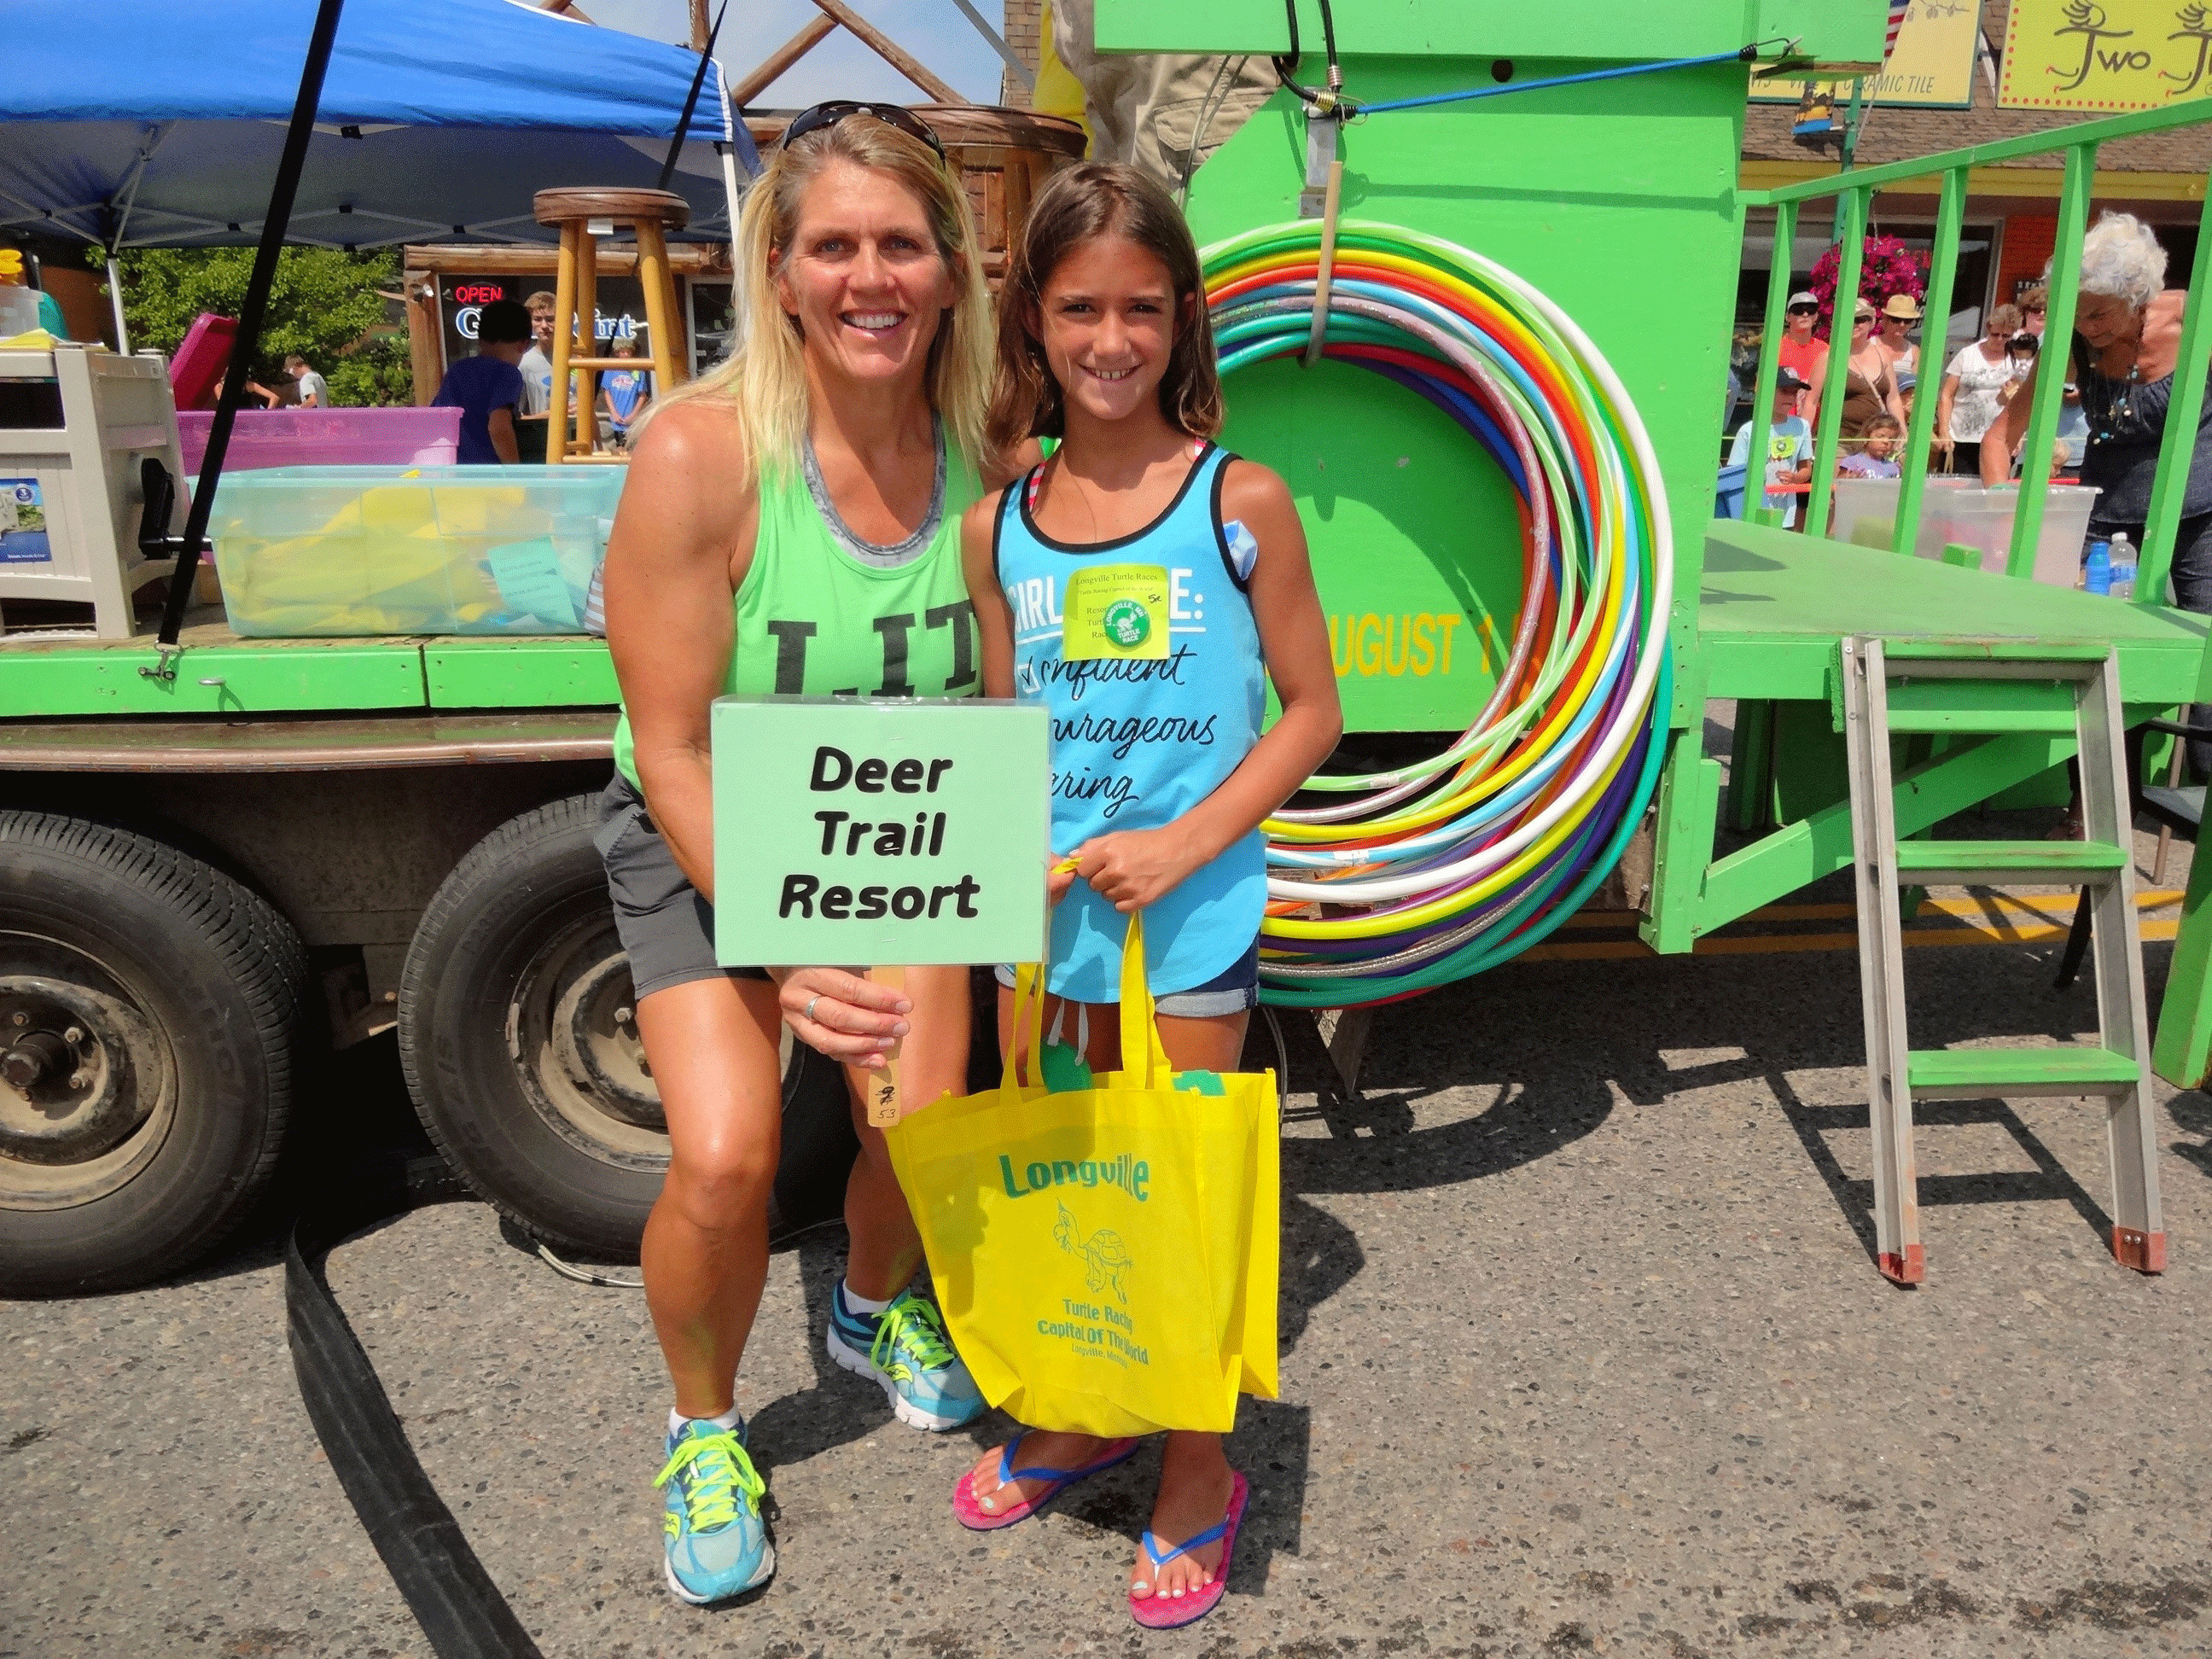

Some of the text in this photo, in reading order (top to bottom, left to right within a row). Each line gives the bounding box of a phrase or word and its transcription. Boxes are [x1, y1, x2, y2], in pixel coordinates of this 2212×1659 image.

[1907, 75, 1936, 94] TILE
[455, 286, 503, 303] OPEN
[1075, 574, 1110, 585] Longville
[1112, 573, 1134, 581] Turtle
[1086, 607, 1108, 615] Resor
[1087, 619, 1103, 627] Turt
[1117, 628, 1141, 638] TURTLE
[1122, 634, 1139, 643] RACE
[1329, 611, 1462, 678] UGUST
[1022, 643, 1198, 701] nfident
[1053, 713, 1218, 760] urageous
[810, 745, 954, 794] Deer
[1051, 766, 1139, 818] ring
[814, 810, 947, 857] Trail
[778, 874, 981, 920] Resort
[998, 1152, 1150, 1202] Longville
[1062, 1297, 1100, 1321] Turtle
[1037, 1319, 1086, 1342] Capital
[1086, 1327, 1104, 1345] Of
